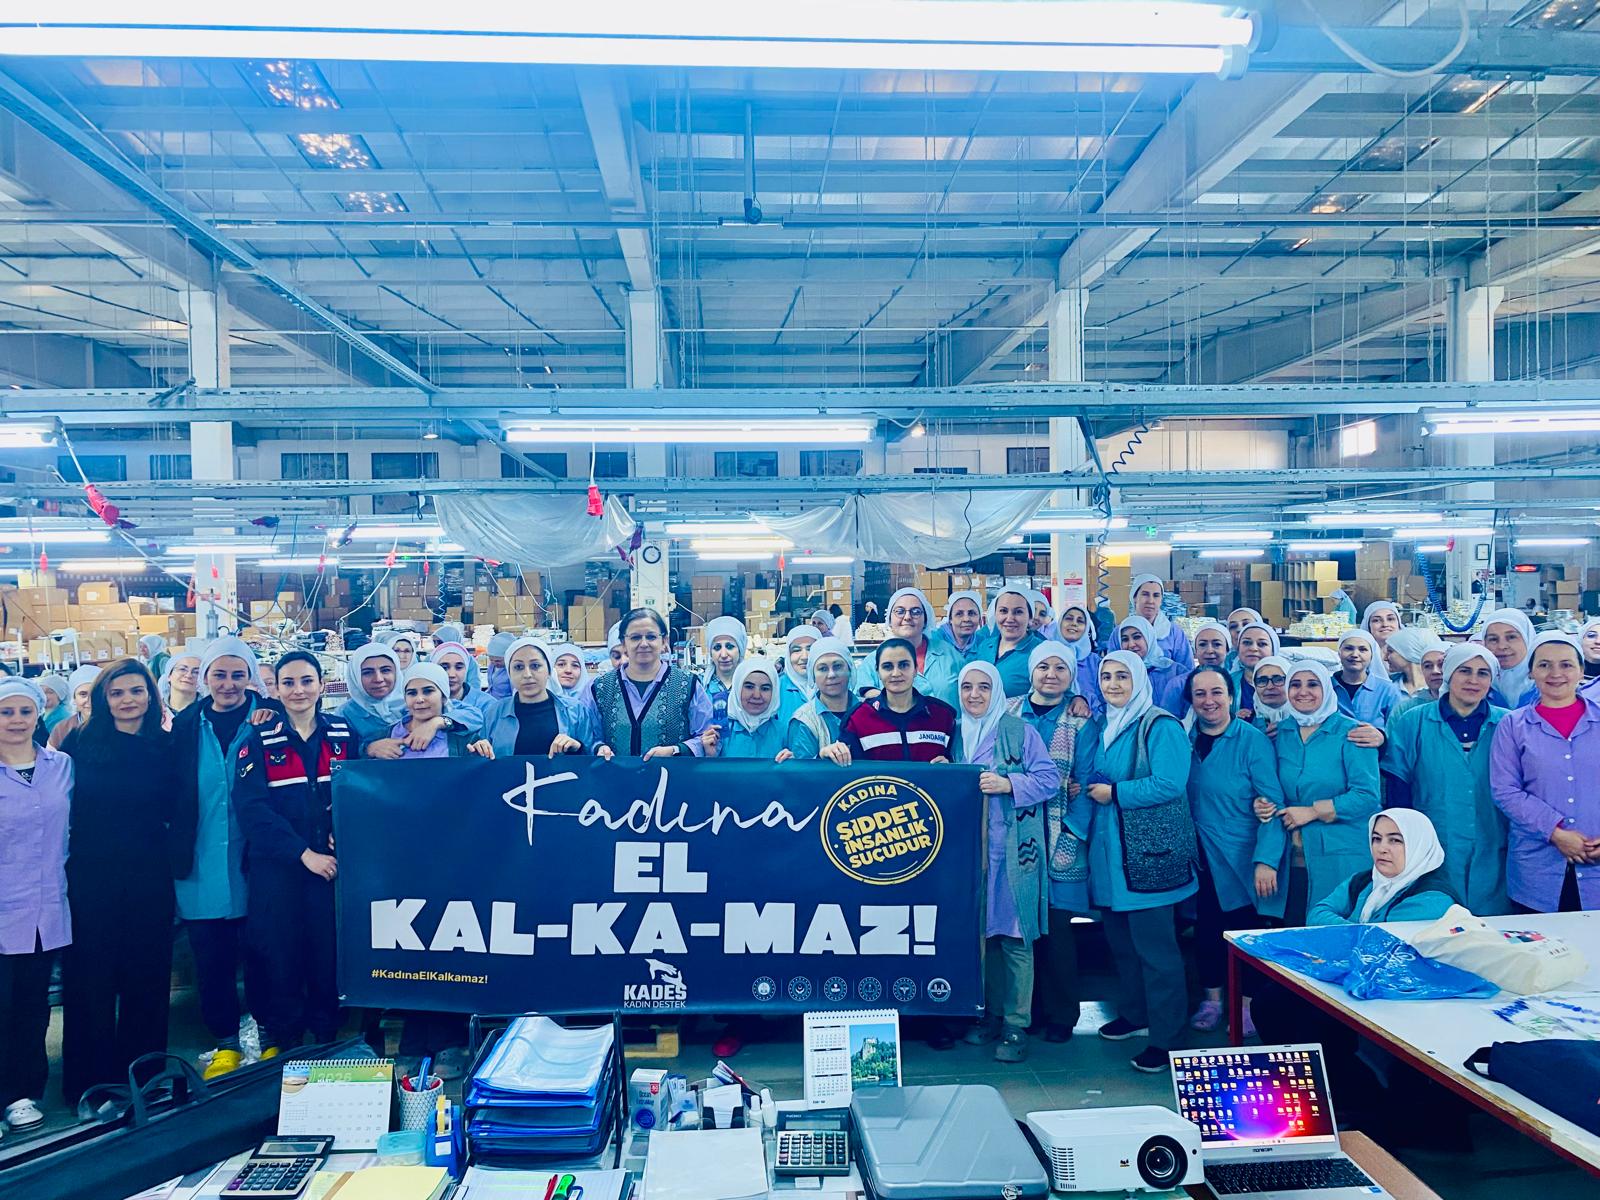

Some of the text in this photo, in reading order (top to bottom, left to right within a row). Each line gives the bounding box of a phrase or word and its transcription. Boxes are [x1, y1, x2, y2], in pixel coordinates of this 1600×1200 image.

[503, 763, 818, 846] Kadına
[837, 784, 898, 812] KADINA
[845, 819, 929, 855] İNSANLIK
[848, 834, 932, 869] SUÇUDUR
[614, 842, 707, 893] EL
[371, 899, 937, 956] KAL-KA-MAZ!
[624, 984, 687, 1001] KADES
[653, 1001, 687, 1009] DESTEK
